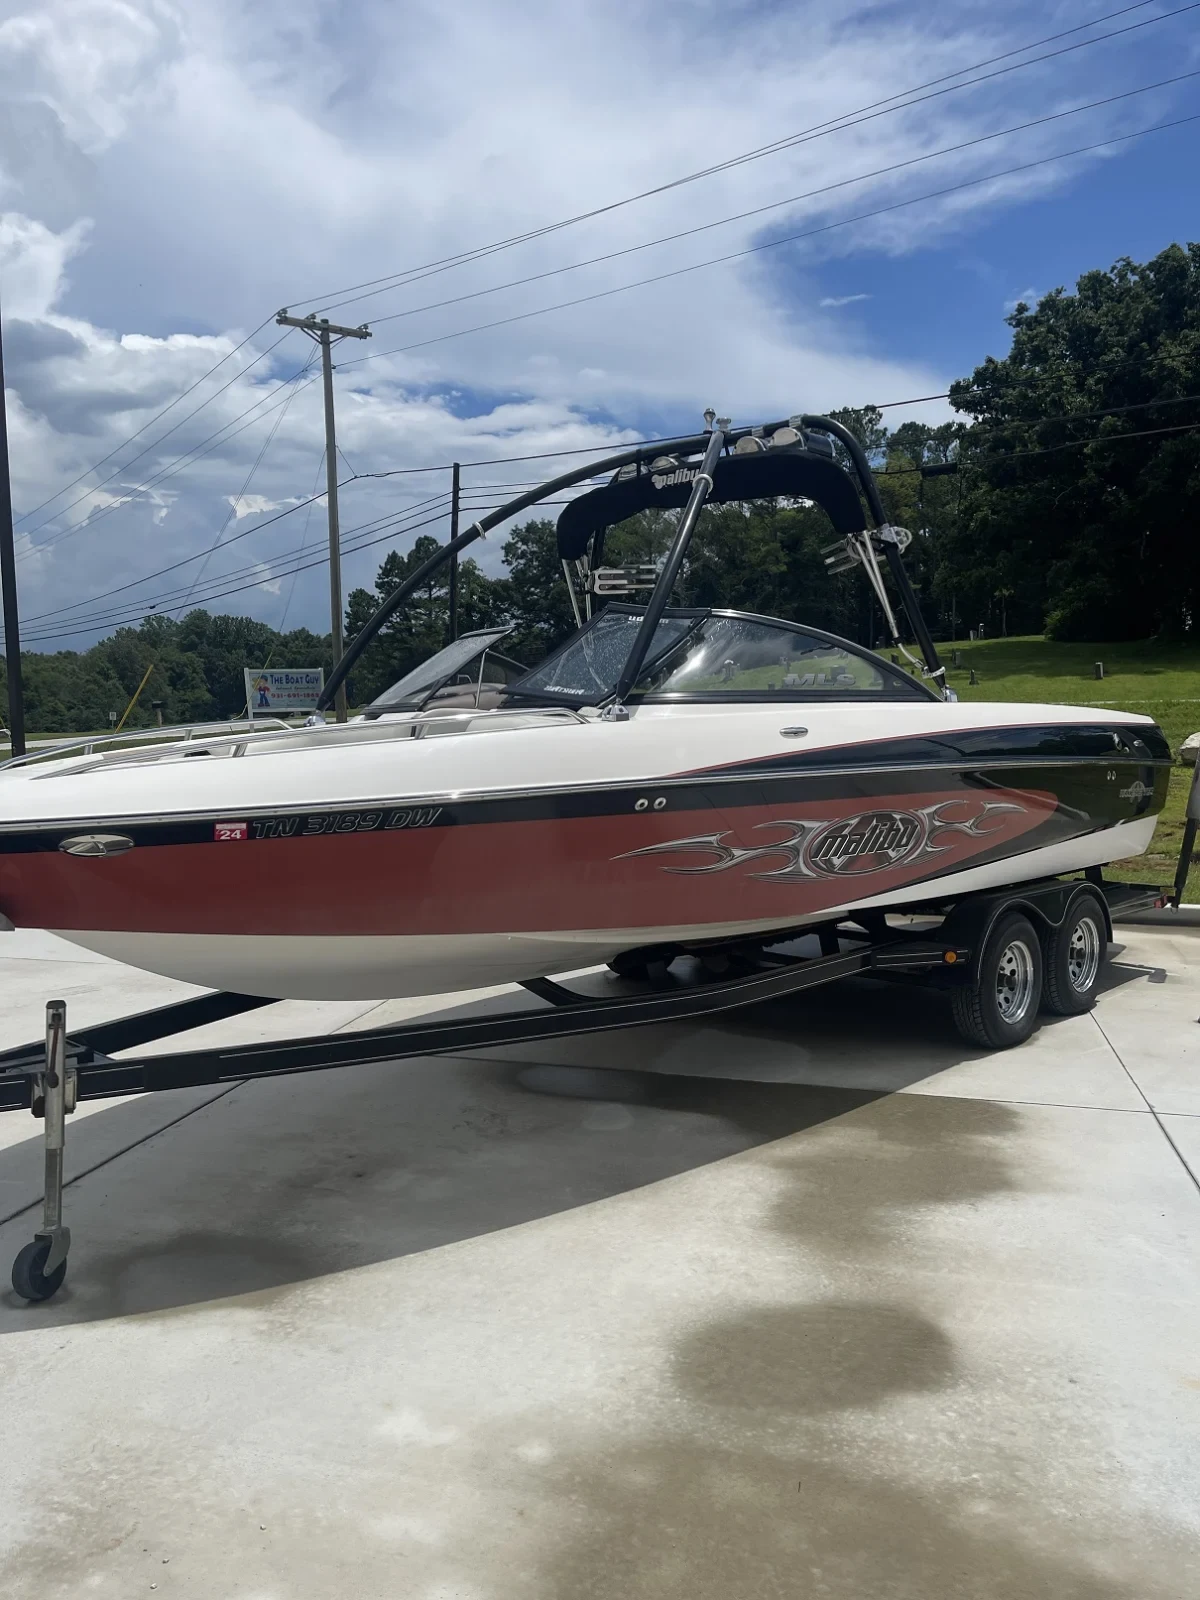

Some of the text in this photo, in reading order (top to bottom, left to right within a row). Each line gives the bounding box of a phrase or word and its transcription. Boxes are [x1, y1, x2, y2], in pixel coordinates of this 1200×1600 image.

[270, 674, 319, 685] THE BOAT GUY
[253, 807, 443, 839] TN 3189 DW
[220, 829, 242, 840] 24
[811, 822, 920, 861] malibu
